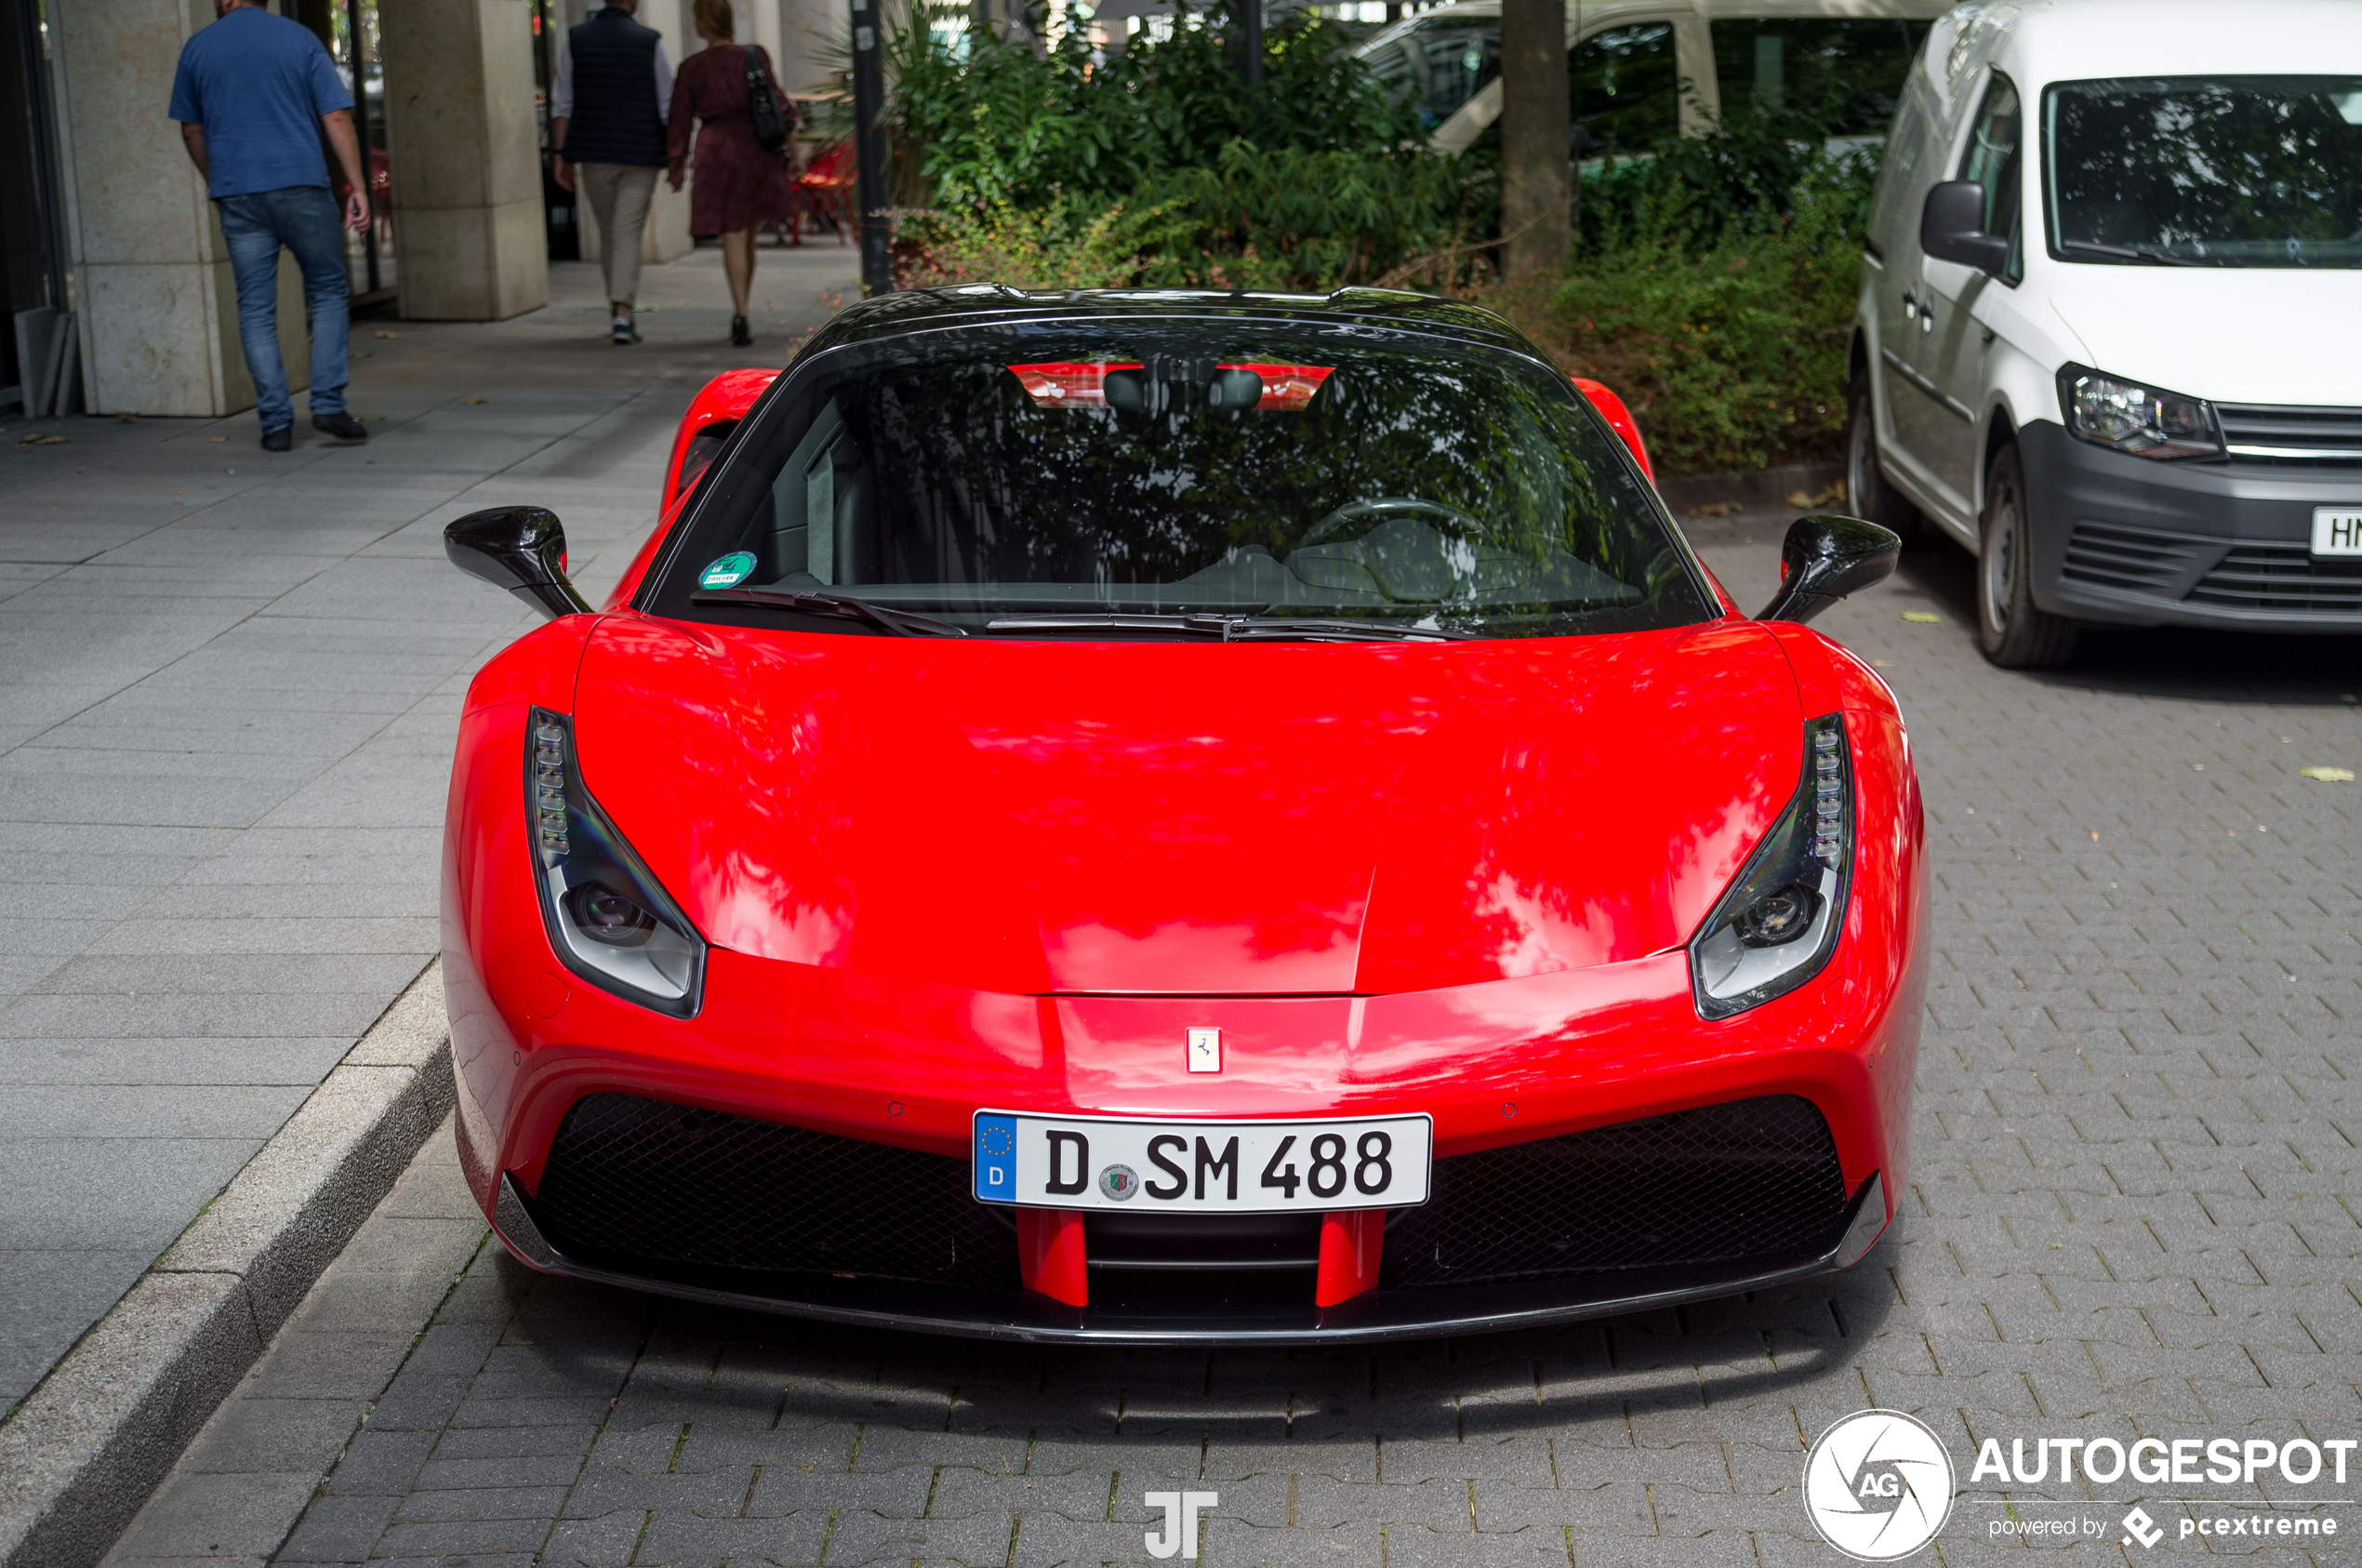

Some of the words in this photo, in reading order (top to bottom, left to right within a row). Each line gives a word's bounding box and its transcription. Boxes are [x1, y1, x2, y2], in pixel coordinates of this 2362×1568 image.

[989, 1166, 1003, 1186] D
[1045, 1129, 1089, 1196] D
[1145, 1134, 1239, 1201] SM
[1260, 1131, 1392, 1199] 488
